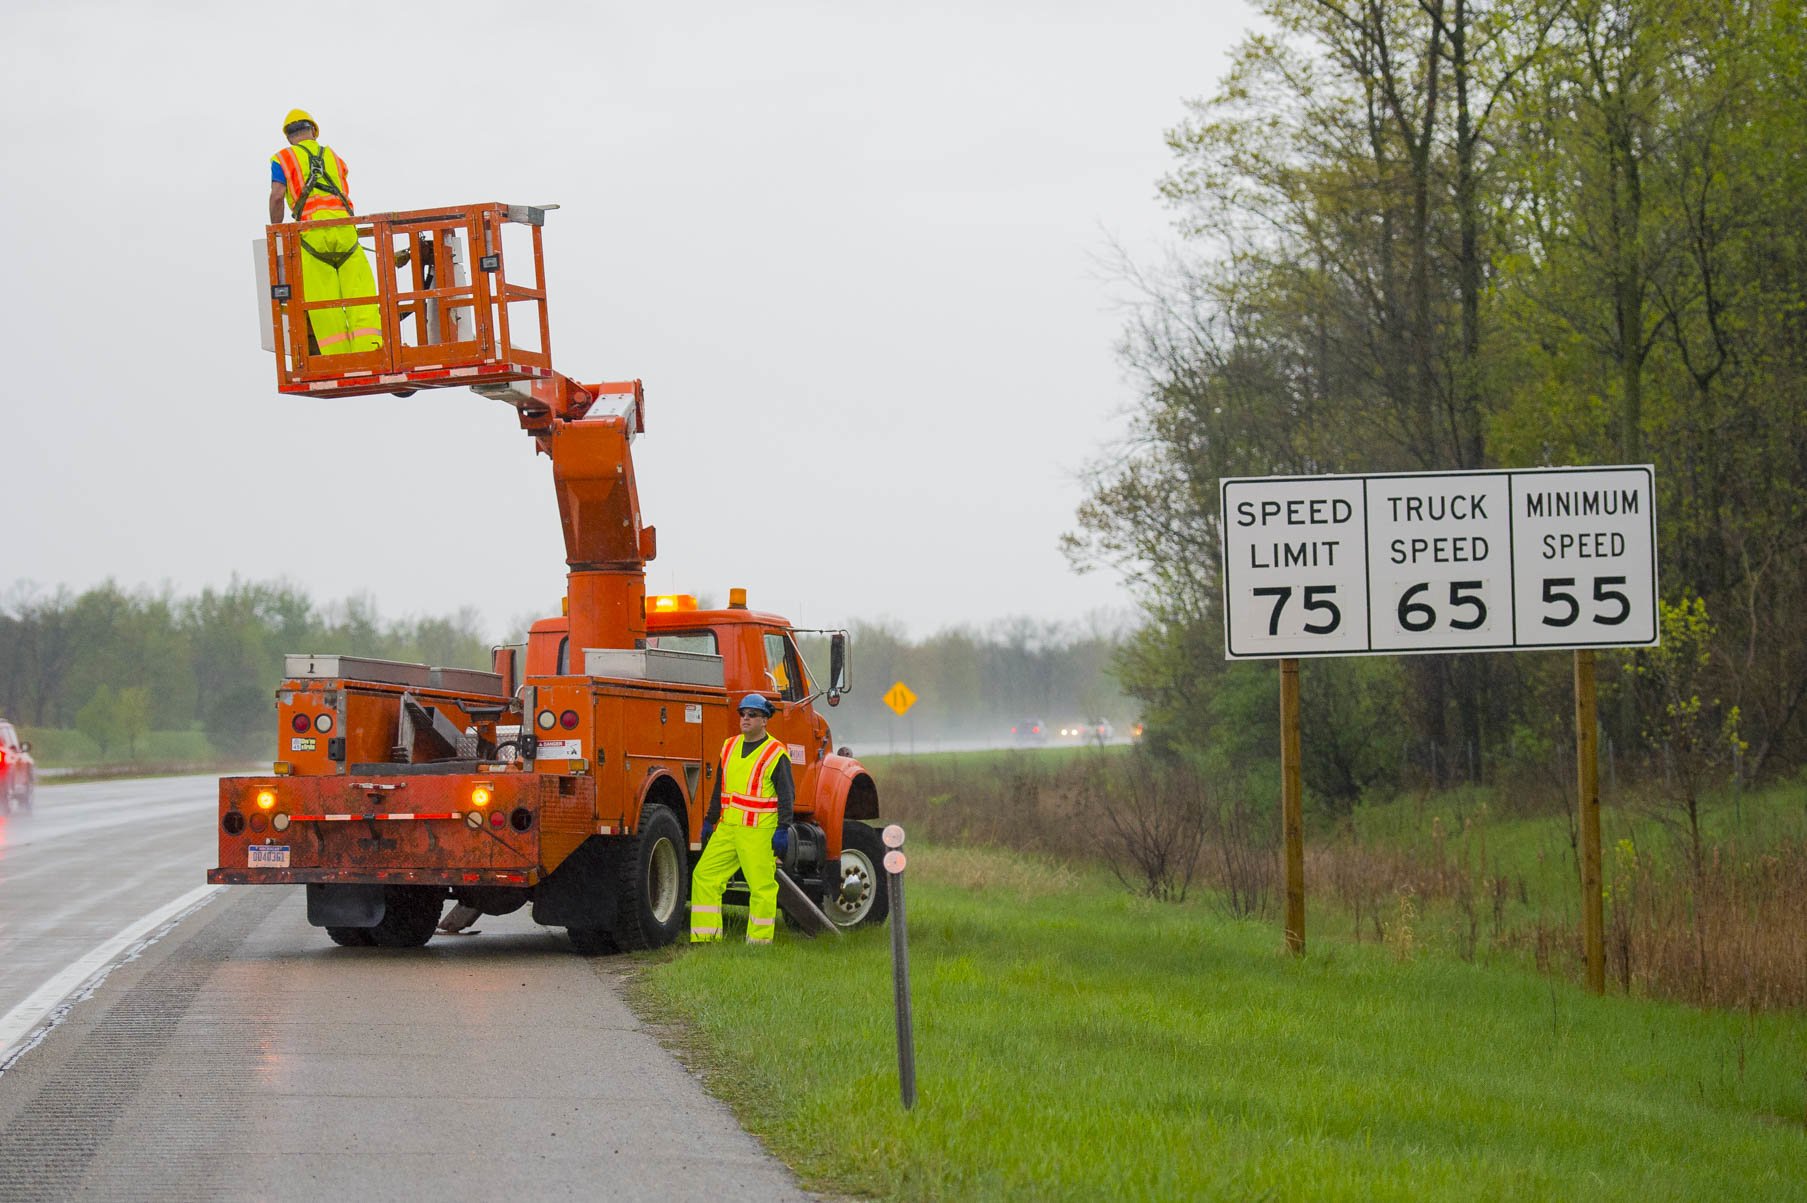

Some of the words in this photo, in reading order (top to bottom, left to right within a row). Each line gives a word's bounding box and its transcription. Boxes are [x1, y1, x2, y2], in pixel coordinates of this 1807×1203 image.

[1238, 499, 1352, 527] SPEED
[1387, 494, 1488, 522] TRUCK
[1527, 490, 1639, 518] MINIMUM
[1251, 542, 1340, 569] LIMIT
[1391, 537, 1489, 564] SPEED
[1543, 532, 1625, 560] SPEED
[1253, 585, 1341, 635] 75
[1398, 581, 1488, 632] 65
[1542, 576, 1631, 627] 55
